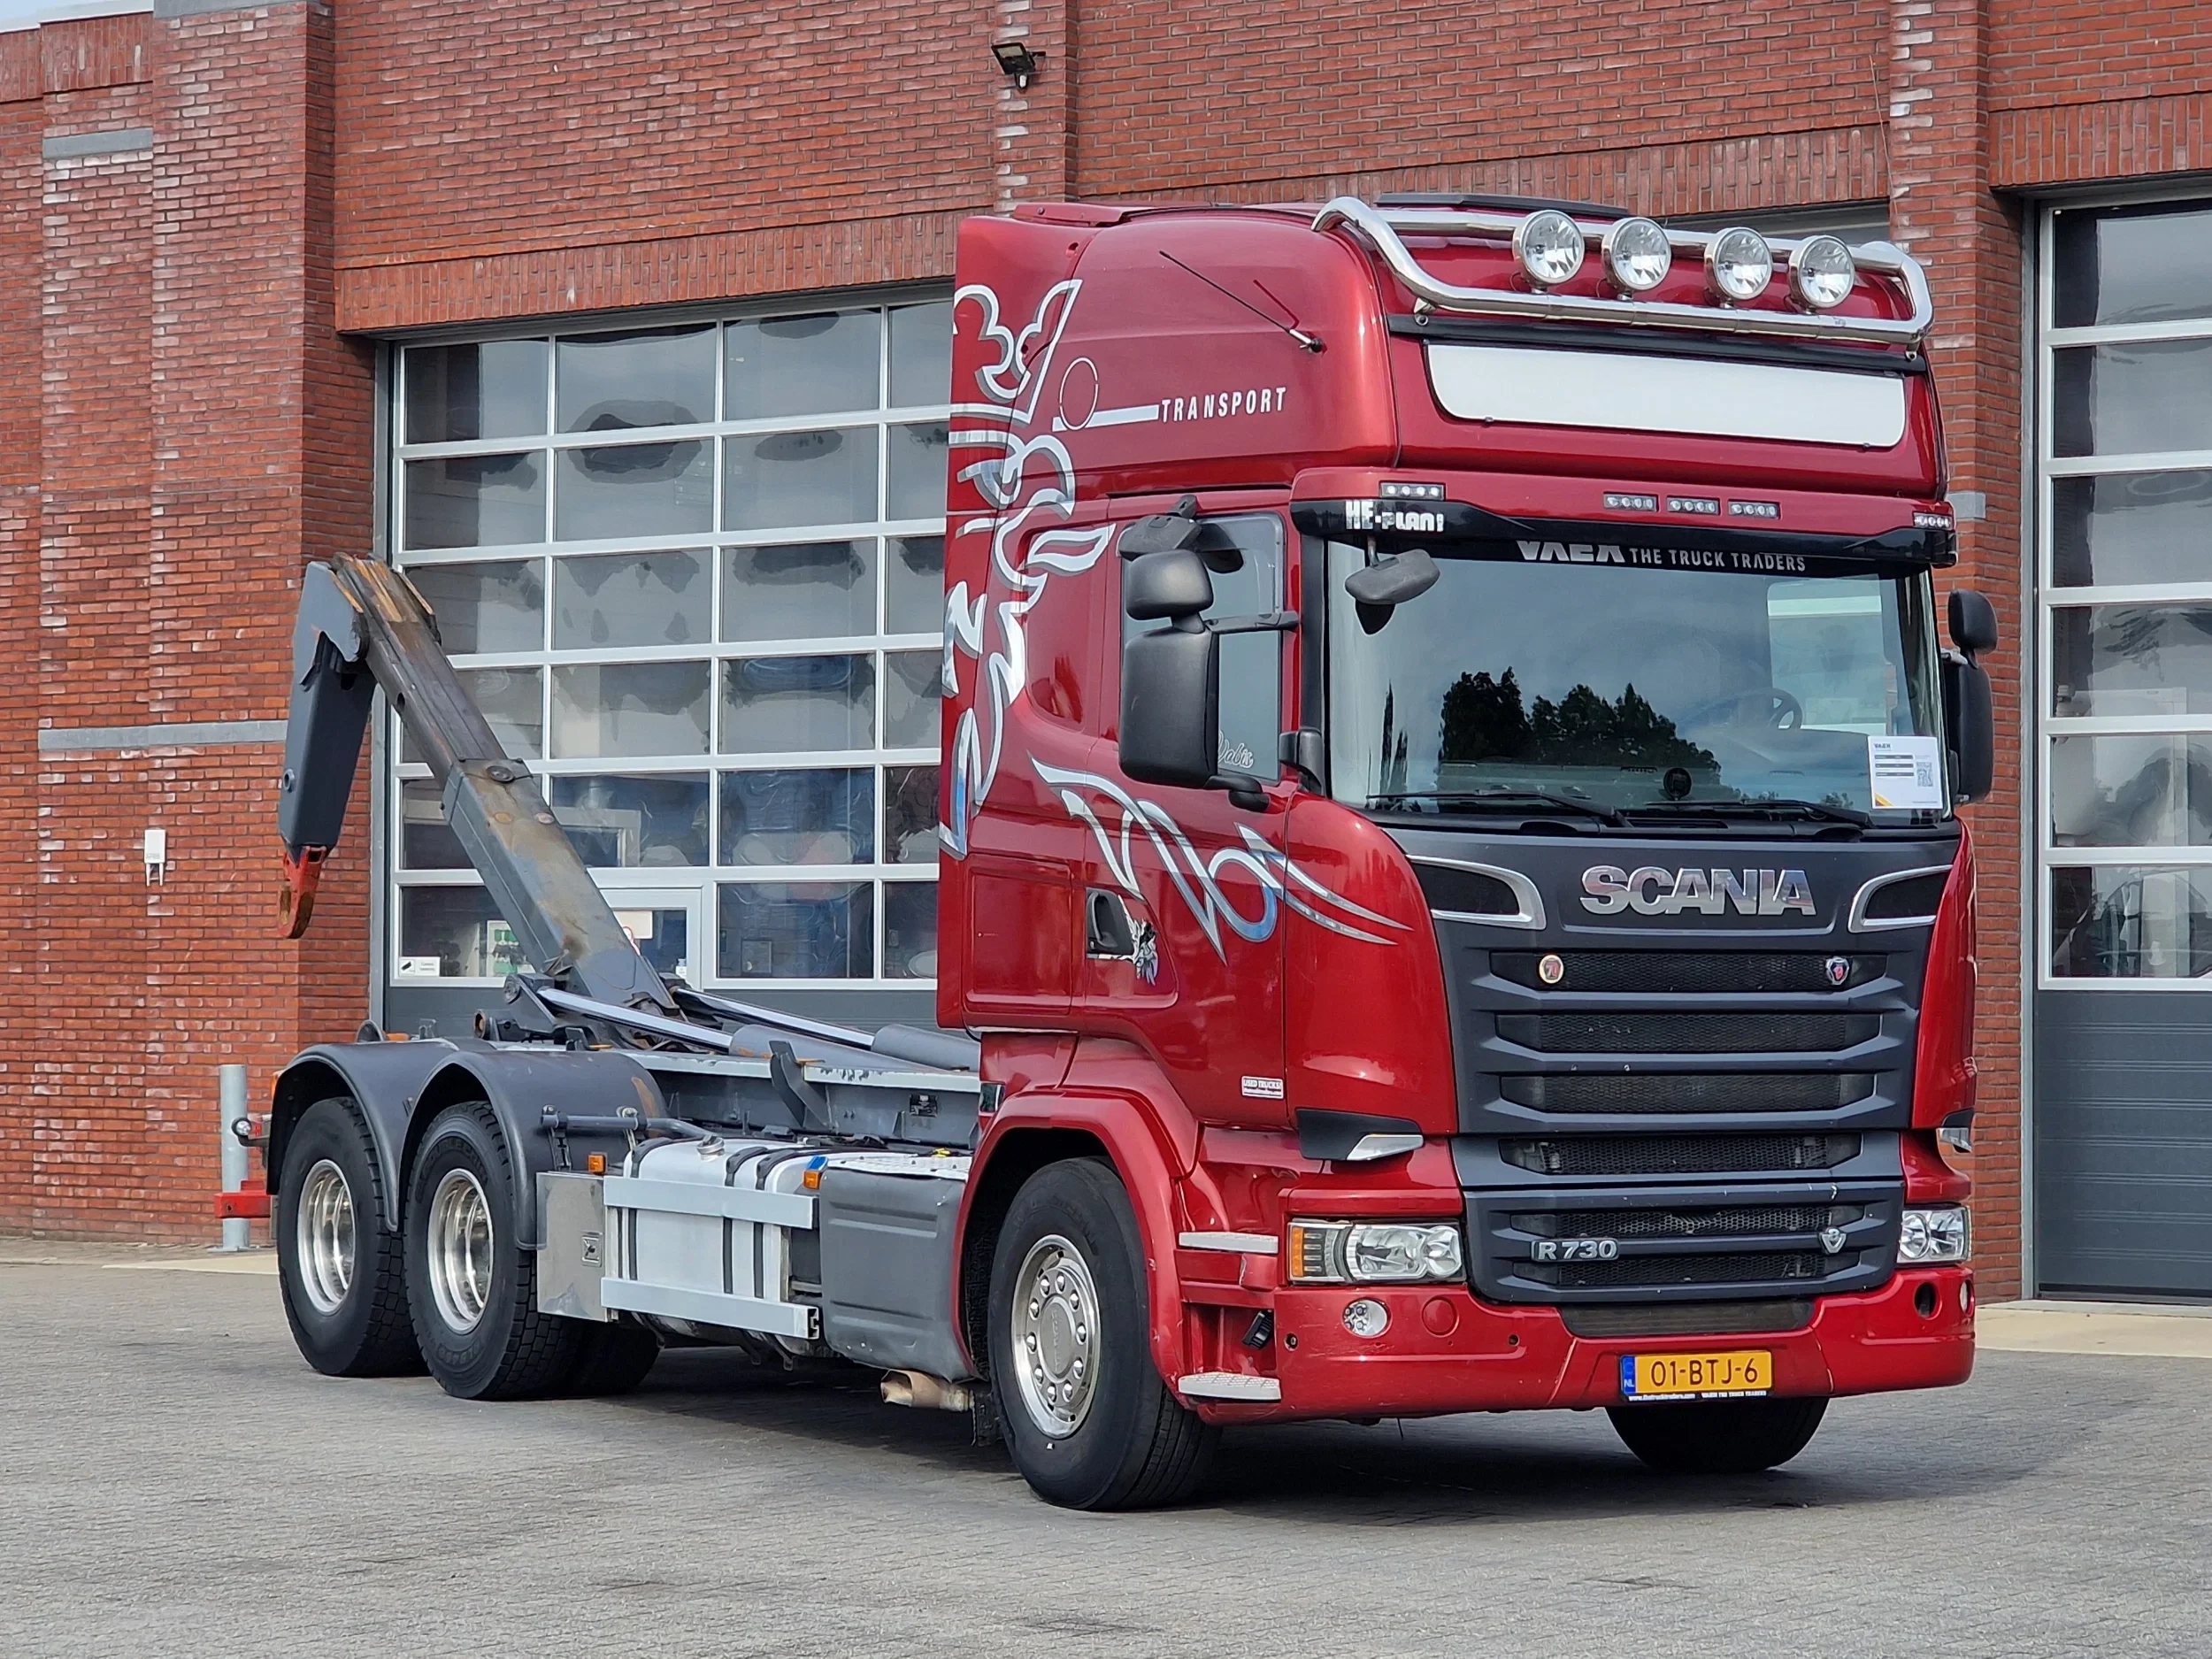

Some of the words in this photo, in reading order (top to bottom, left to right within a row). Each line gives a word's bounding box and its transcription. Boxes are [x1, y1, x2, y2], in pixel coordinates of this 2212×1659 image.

[1162, 387, 1286, 423] TRANSPORT
[1630, 548, 1663, 565] THE
[1668, 549, 1725, 567] TRUCK
[1731, 552, 1806, 572] TRADERS
[1579, 865, 1816, 915] SCANIA
[1539, 1241, 1557, 1260] R
[1561, 1240, 1617, 1259] 730
[1624, 1379, 1634, 1387] NL
[1651, 1357, 1758, 1386] 01-BTJ-6
